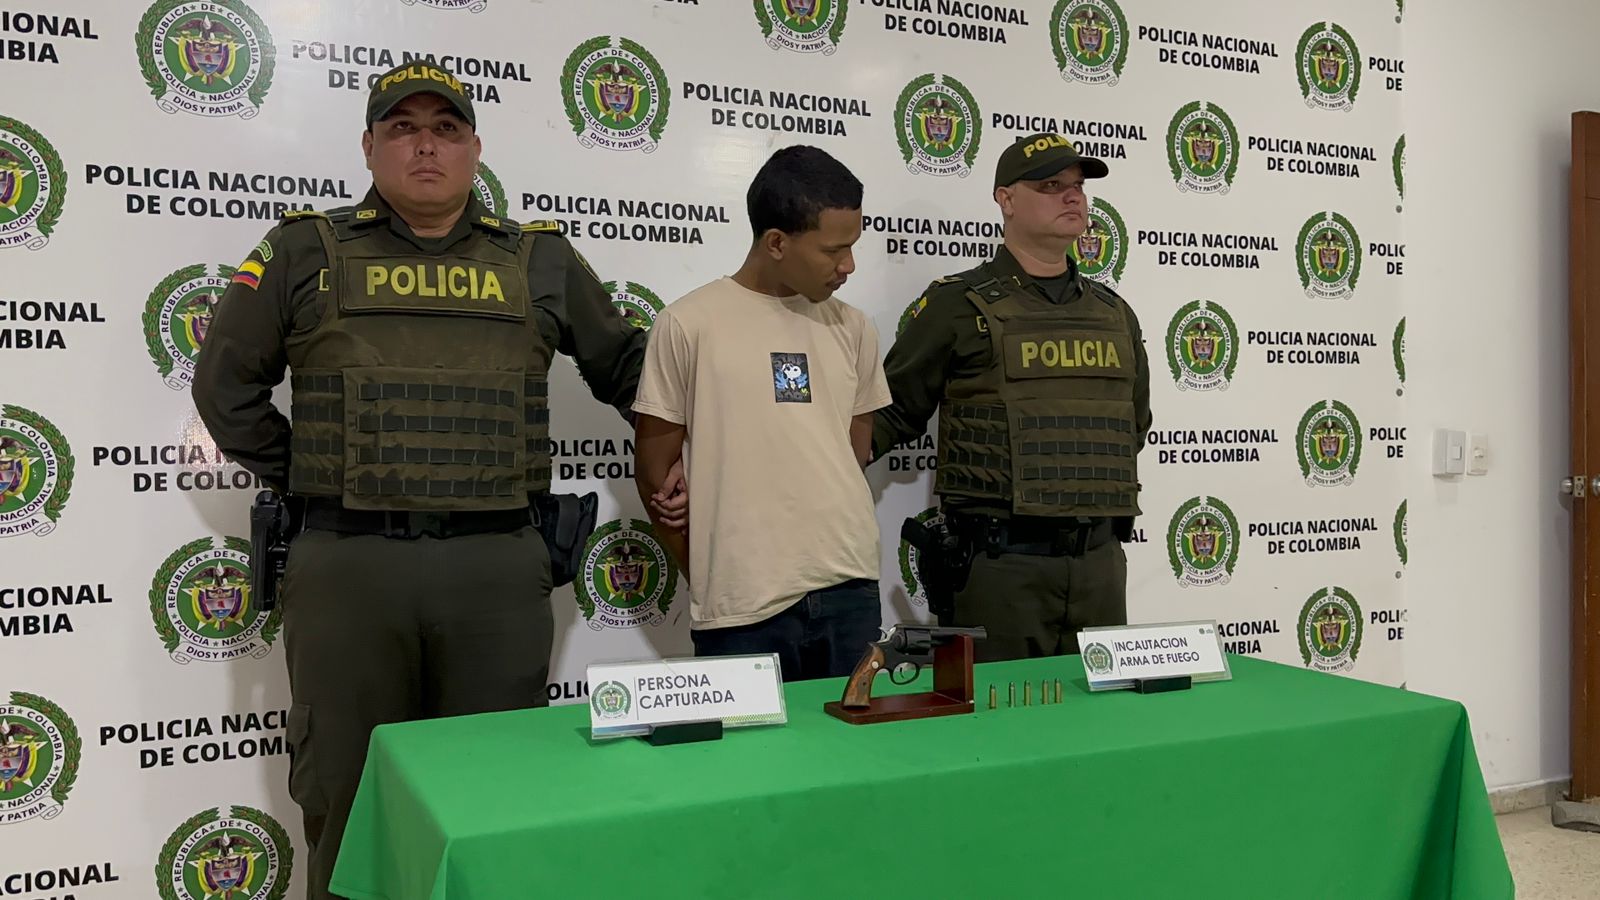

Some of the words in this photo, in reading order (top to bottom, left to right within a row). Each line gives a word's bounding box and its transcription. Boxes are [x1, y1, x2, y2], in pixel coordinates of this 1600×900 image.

[938, 0, 1028, 25] NACIONAL
[886, 14, 906, 31] DE
[913, 18, 1006, 43] COLOMBIA
[0, 39, 59, 64] BIA
[1139, 26, 1198, 46] POLICIA
[1203, 34, 1278, 57] NACIONAL
[292, 40, 394, 67] POLICIA
[1160, 48, 1177, 63] DE
[1182, 51, 1259, 73] COLOMBIA
[329, 70, 359, 90] DE
[381, 65, 464, 96] POLICIA
[1387, 77, 1402, 91] DE
[684, 82, 763, 106] POLICIA
[770, 92, 871, 116] NACIONAL
[712, 109, 735, 126] DE
[743, 112, 846, 136] COLOMBIA
[993, 113, 1058, 133] POLICIA
[1064, 120, 1147, 140] NACIONAL
[1073, 141, 1127, 159] OMBIA
[1249, 137, 1303, 154] POLICIA
[1307, 142, 1376, 161] NACIONAL
[1268, 157, 1283, 171] DE
[1288, 159, 1359, 177] COLOMBIA
[86, 165, 200, 189] POLICIA
[209, 172, 352, 198] NACIONAL
[127, 194, 160, 214] DE
[523, 193, 611, 215] POLICIA
[619, 200, 729, 222] NACIONAL
[588, 222, 703, 244] COLOMBIA
[862, 216, 933, 234] POLICIA
[938, 219, 1005, 238] NACION
[0, 231, 32, 245] ATRIA
[1139, 231, 1197, 246] POLICIA
[1203, 234, 1278, 250] NACIONAL
[887, 239, 908, 254] DE
[913, 240, 996, 258] COLOMBI
[1159, 251, 1176, 265] DE
[1182, 252, 1259, 268] COLOMBIA
[1387, 262, 1402, 274] DE
[366, 265, 505, 303] POLICIA
[1248, 331, 1303, 345] POLICIA
[1307, 333, 1376, 346] NACIONAL
[1021, 340, 1121, 368] POLICIA
[1268, 350, 1283, 363] DE
[1288, 351, 1359, 364] COLOMBIA
[1148, 431, 1197, 445] OLICIA
[1203, 430, 1278, 443] NACIONAL
[93, 445, 207, 466] POLICIA
[550, 439, 617, 457] OLICIA
[1159, 450, 1176, 463] DE
[1182, 448, 1259, 463] COLOMBIA
[1387, 445, 1403, 458] DE
[560, 463, 586, 480] DE
[889, 455, 910, 471] DE
[134, 473, 167, 492] DE
[1249, 522, 1303, 536] POLICIA
[1308, 518, 1377, 533] NACIONAL
[1269, 541, 1284, 554] DE
[1289, 537, 1360, 553] COLOMBIA
[1218, 620, 1280, 637] ACIONAL
[1114, 637, 1188, 652] INCAUTACION
[1120, 655, 1149, 667] ARMA
[1151, 653, 1165, 665] DE
[1167, 651, 1200, 663] FUEGO
[638, 674, 711, 692] PERSONA
[639, 690, 735, 709] CAPTURADA
[100, 718, 213, 745] POLICIA
[141, 747, 173, 768] DE
[0, 862, 119, 896] CIONAL
